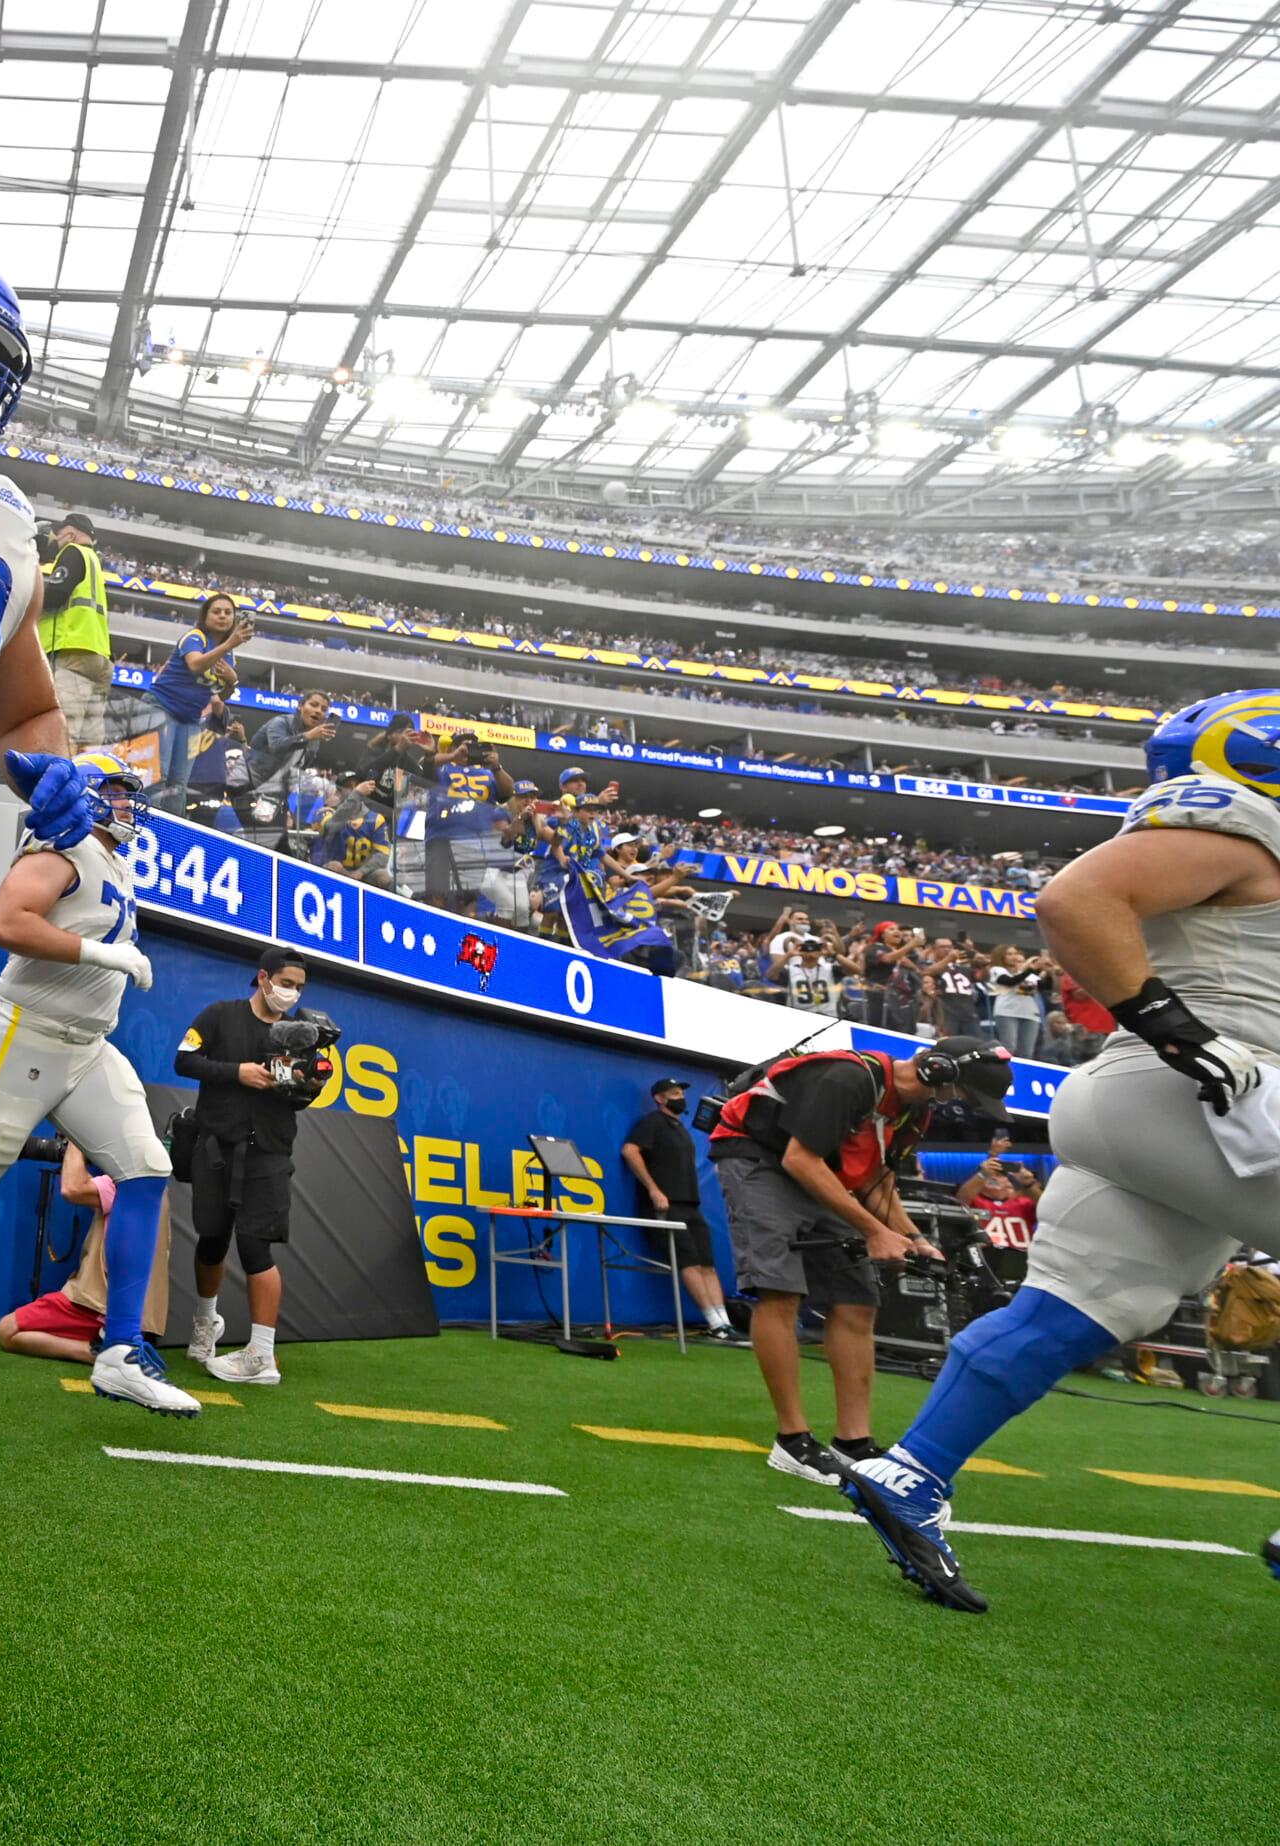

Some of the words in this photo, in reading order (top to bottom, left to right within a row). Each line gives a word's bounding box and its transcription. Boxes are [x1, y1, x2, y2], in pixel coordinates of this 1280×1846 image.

[118, 668, 143, 686] 2.0
[255, 693, 290, 708] Fumble
[346, 705, 358, 720] 0
[370, 710, 390, 724] INT:
[487, 728, 530, 743] Season
[579, 740, 608, 754] Sacks:
[641, 748, 673, 762] Forced
[674, 753, 713, 767] Fumbles:
[714, 756, 723, 769] 1
[448, 773, 489, 801] 25
[738, 760, 772, 773] Fumble
[772, 764, 824, 781] Recoveries:
[825, 769, 835, 783] 1
[869, 774, 880, 788] 3
[724, 856, 889, 901] VAMOS
[915, 881, 1038, 920] RAMS
[124, 826, 244, 916] 8:44
[293, 880, 344, 943] Q1
[565, 960, 595, 1015] 0
[942, 973, 971, 993] 12
[985, 1216, 1030, 1249] 40
